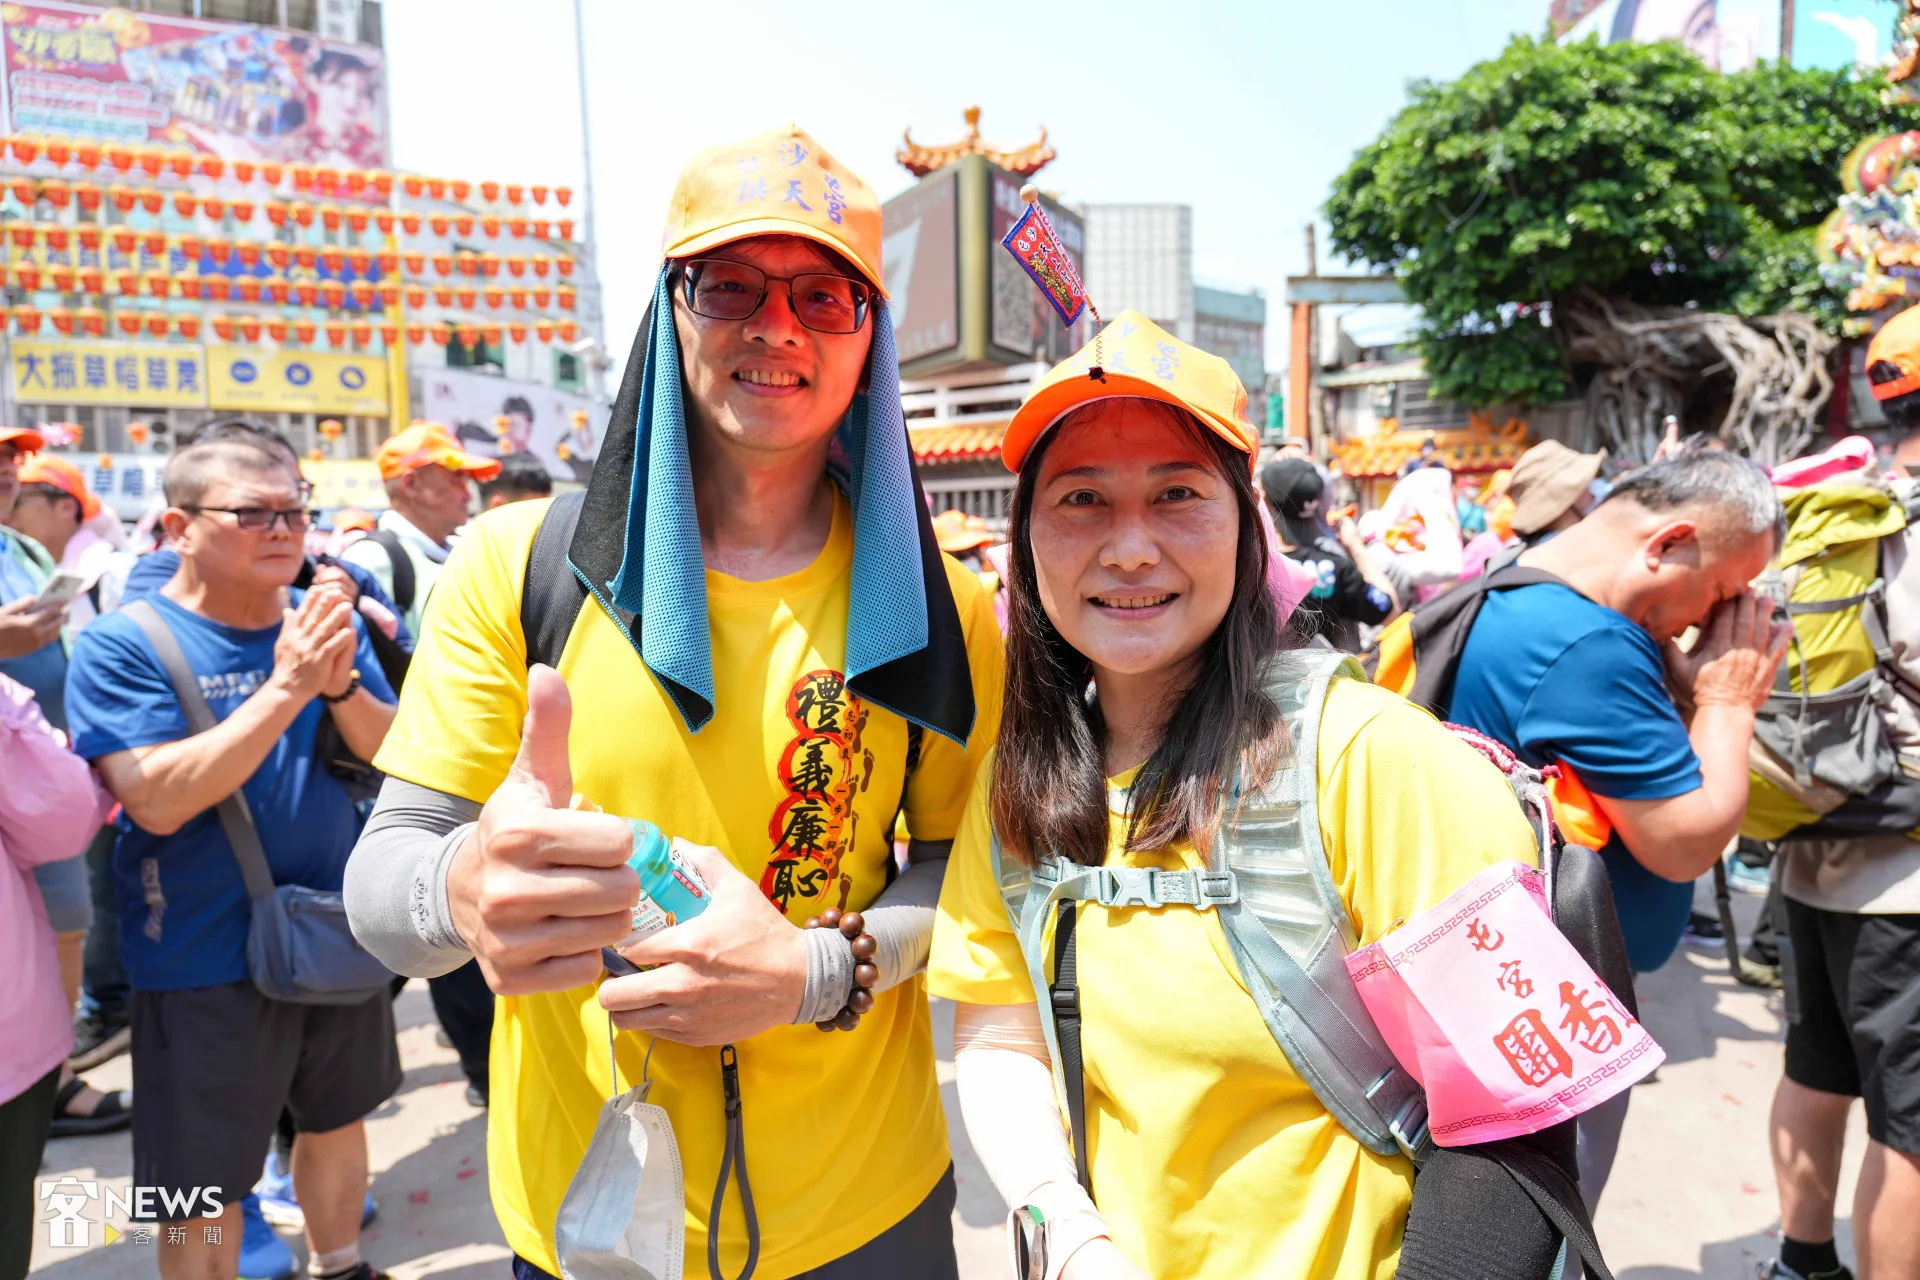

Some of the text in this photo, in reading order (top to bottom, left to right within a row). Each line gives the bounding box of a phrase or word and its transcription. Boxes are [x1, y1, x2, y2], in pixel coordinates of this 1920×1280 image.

[768, 672, 846, 914] 禮義廉恥
[1493, 972, 1640, 1088] 香團
